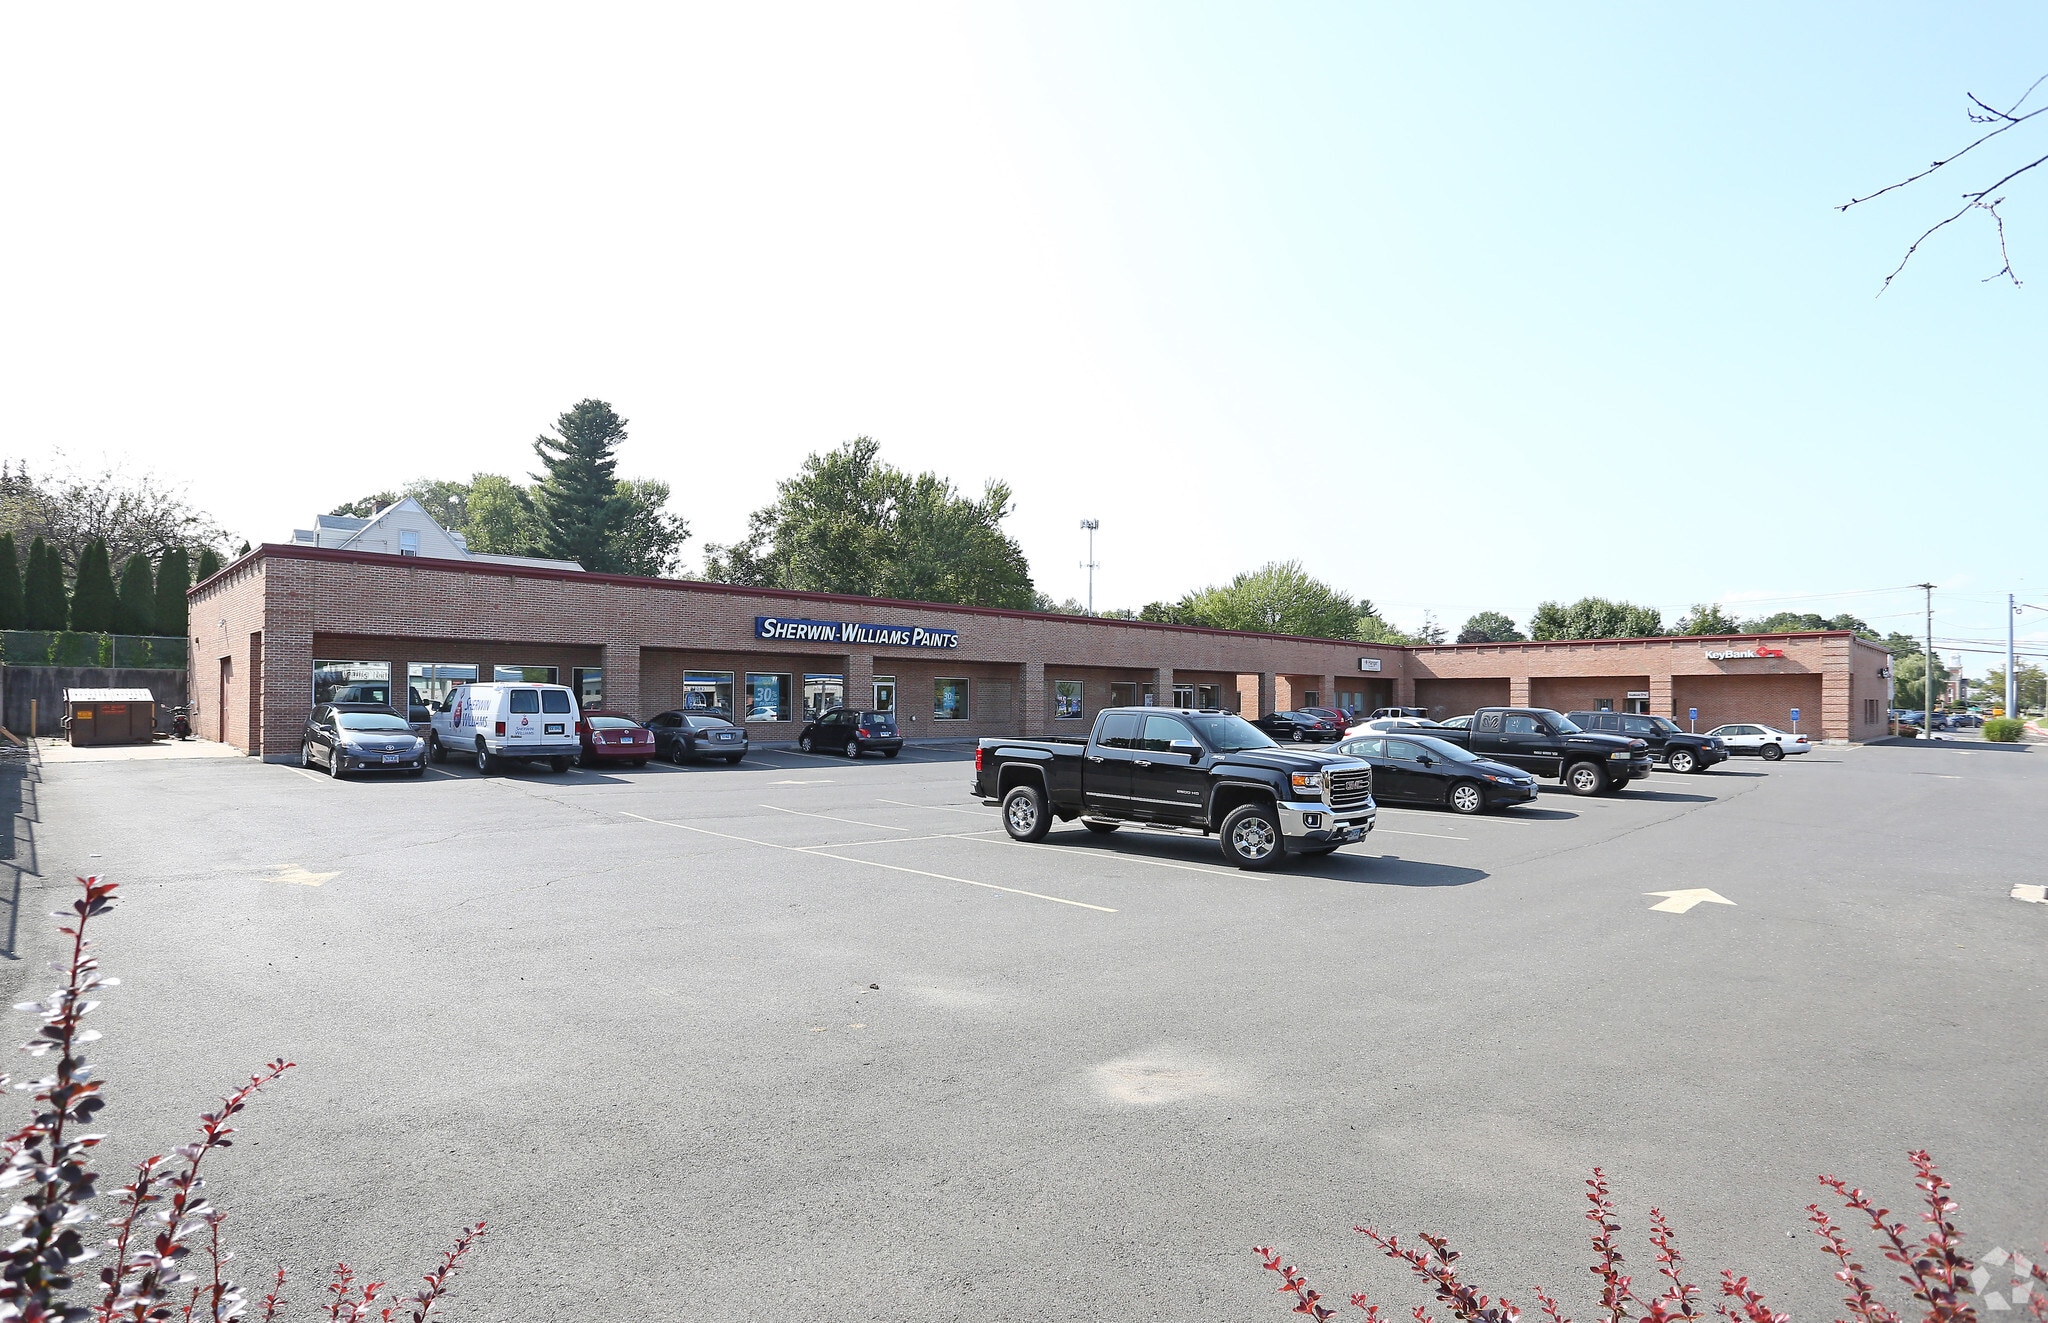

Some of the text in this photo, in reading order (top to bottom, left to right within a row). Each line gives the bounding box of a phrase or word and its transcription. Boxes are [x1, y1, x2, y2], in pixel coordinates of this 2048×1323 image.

[761, 618, 959, 648] SHERWIN-WILLIAMS PAINTS
[1705, 649, 1755, 660] KeyBank
[464, 697, 492, 711] SHERWIN
[462, 712, 488, 728] WILLIAMS
